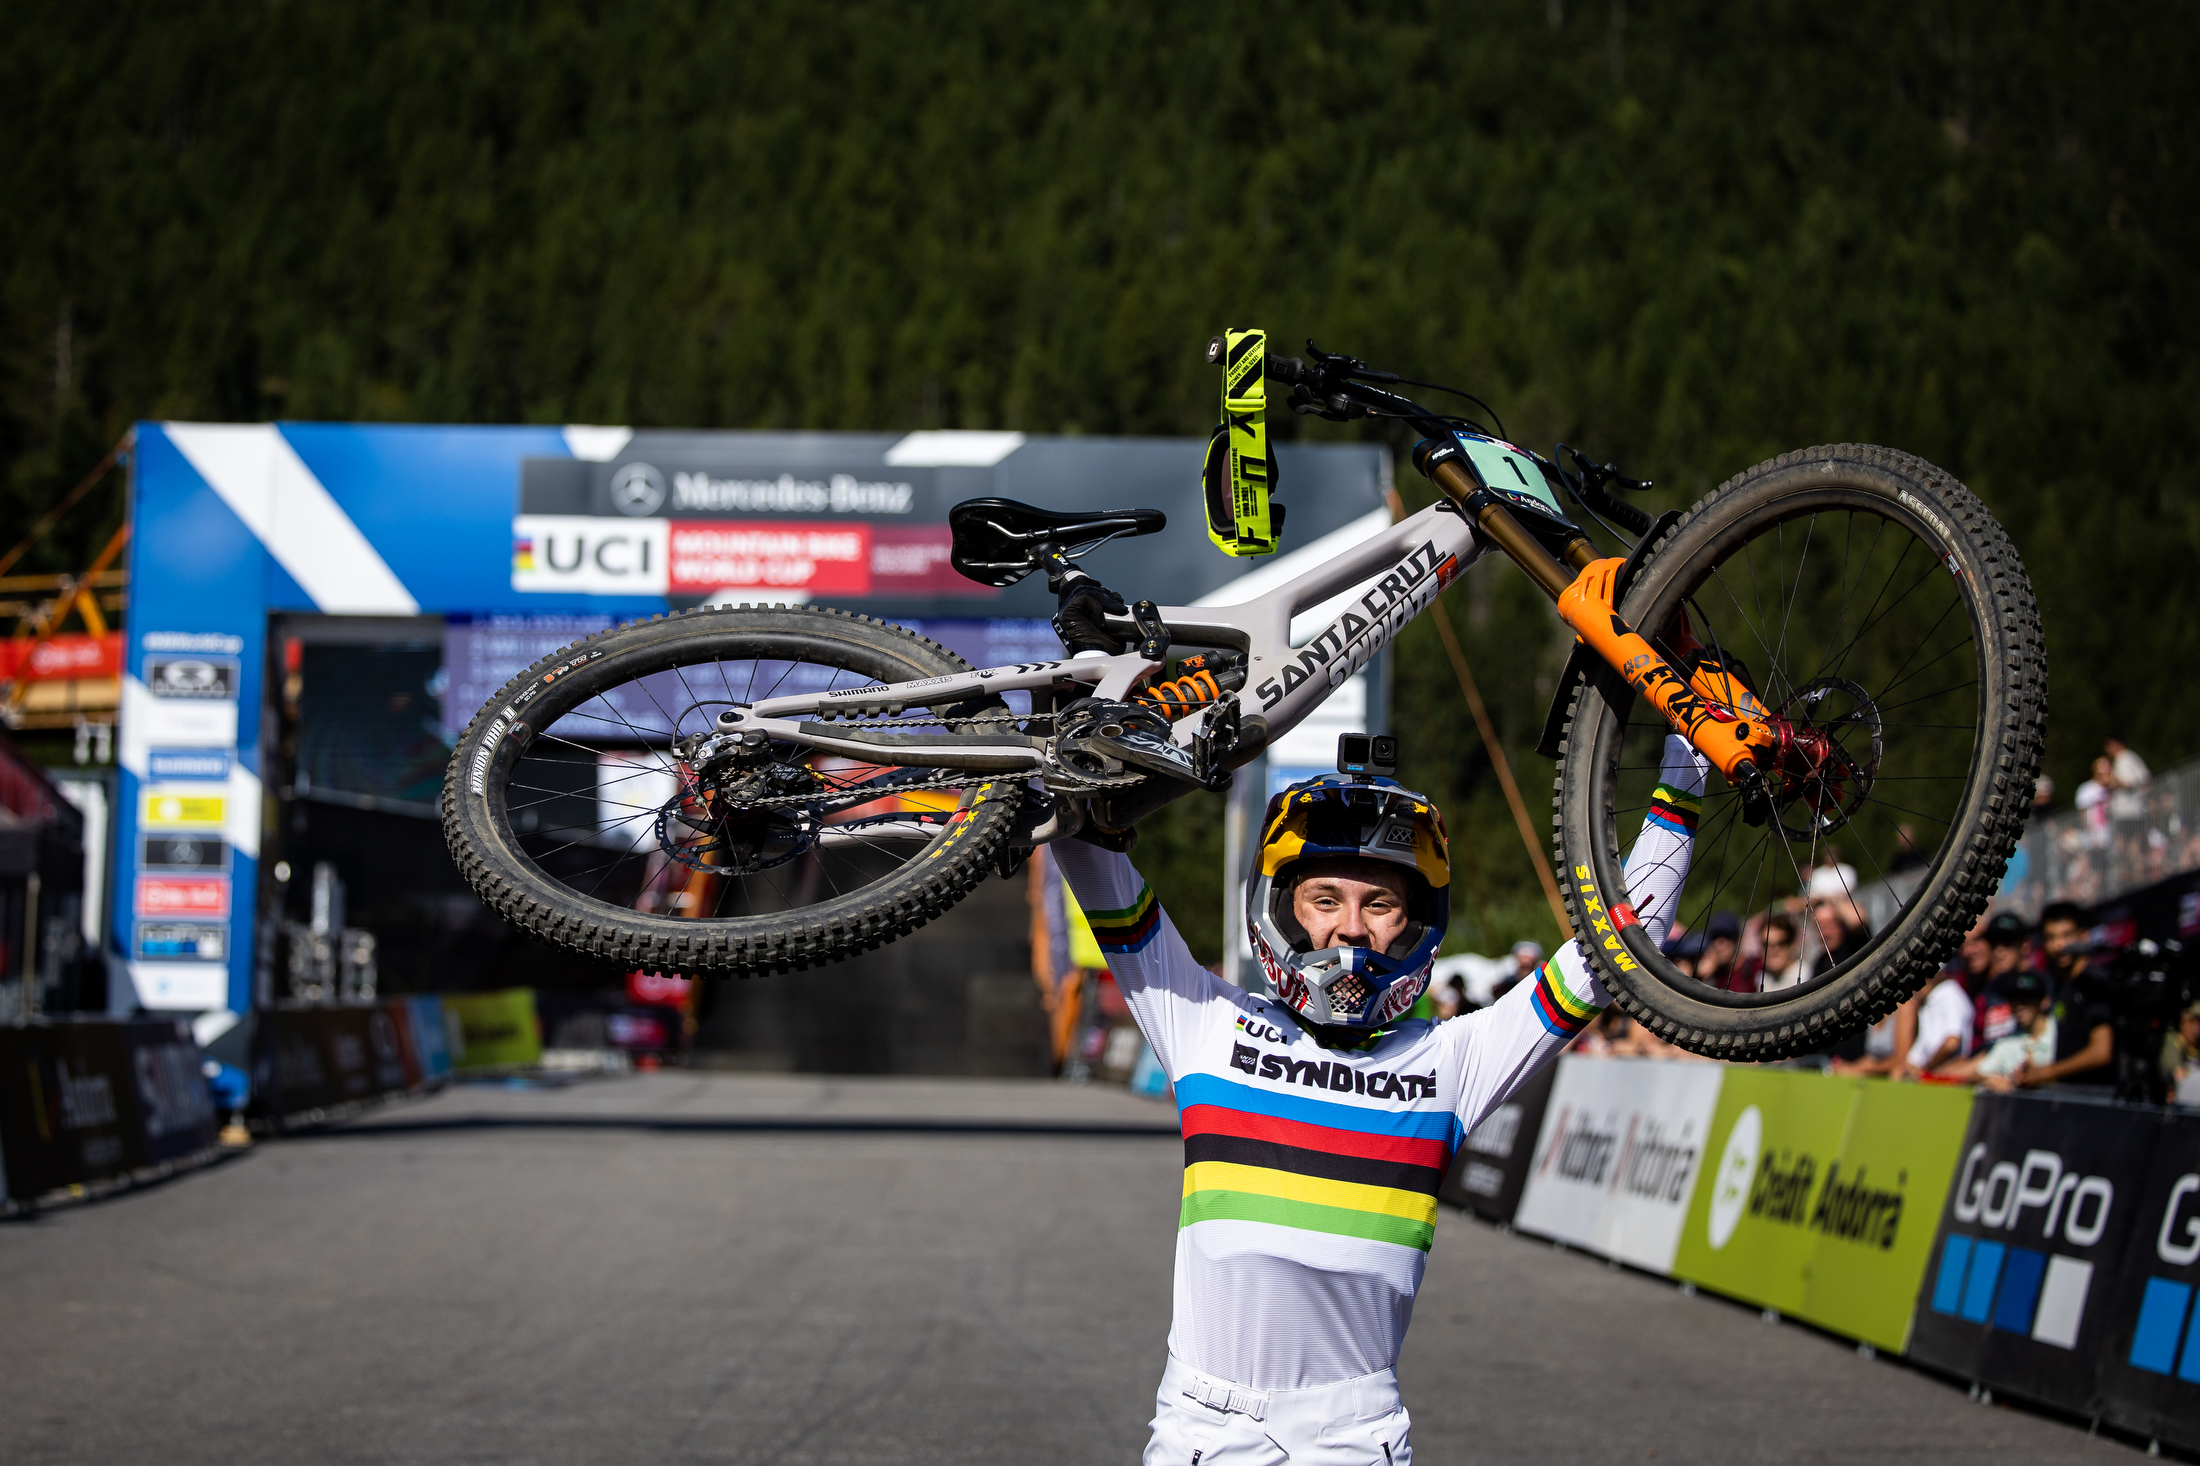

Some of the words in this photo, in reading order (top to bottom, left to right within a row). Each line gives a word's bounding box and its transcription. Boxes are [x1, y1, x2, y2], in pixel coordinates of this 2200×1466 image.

[1231, 446, 1239, 478] FUTURE
[1502, 456, 1529, 486] 1
[673, 472, 913, 513] Mercedes-Benz
[1233, 479, 1241, 518] ELEVATED
[546, 536, 651, 574] UCI
[673, 531, 803, 557] MOUNTAIN
[806, 532, 861, 560] BIKE
[673, 557, 761, 584] WORLD
[763, 558, 816, 585] CUP
[1255, 612, 1369, 714] SANTA
[1361, 539, 1447, 619] CRUZ
[828, 684, 890, 698] SHIMANO
[906, 676, 953, 689] MAXXIS
[471, 746, 491, 797] MINION
[482, 718, 507, 750] DHR
[1575, 864, 1638, 972] MAXXIS
[1259, 1053, 1437, 1102] SYNDICATE
[1954, 1142, 2113, 1246] GoPro
